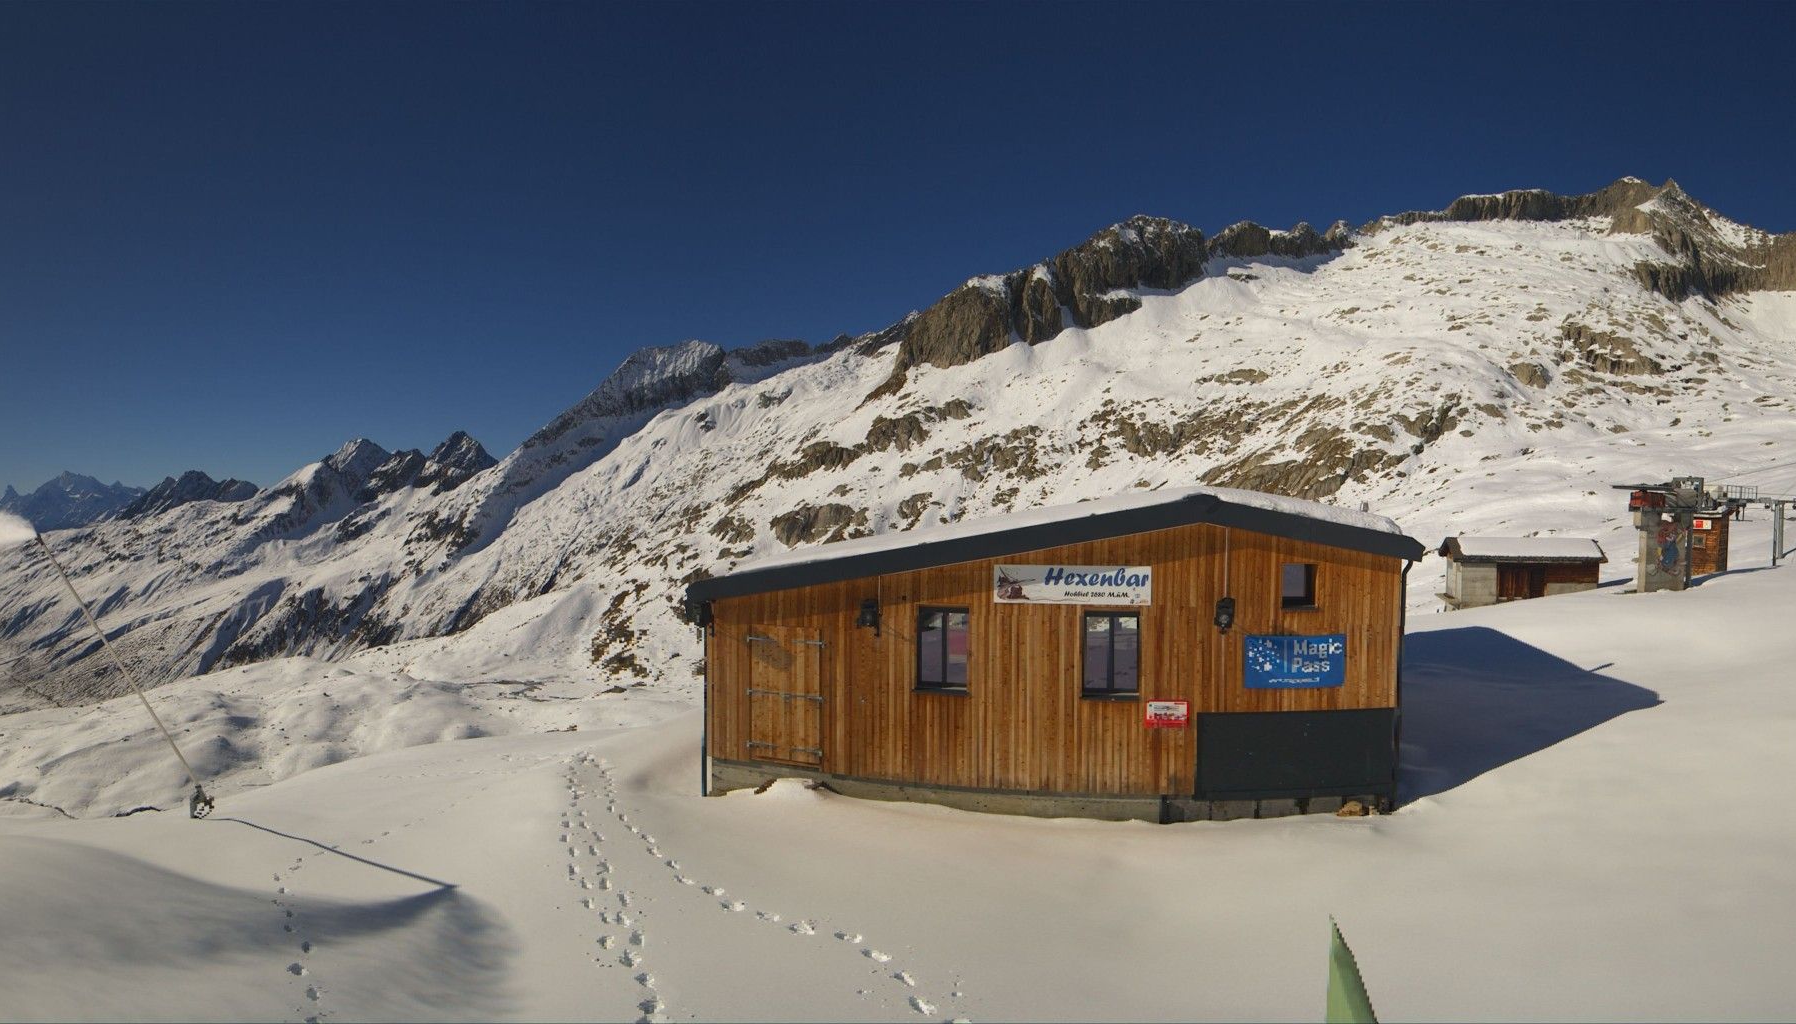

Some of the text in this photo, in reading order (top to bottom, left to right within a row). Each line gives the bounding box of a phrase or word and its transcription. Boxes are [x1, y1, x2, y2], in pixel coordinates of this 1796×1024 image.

[1044, 567, 1149, 588] Hexenbar
[1293, 638, 1343, 659] Magic
[1291, 657, 1330, 673] Pass
